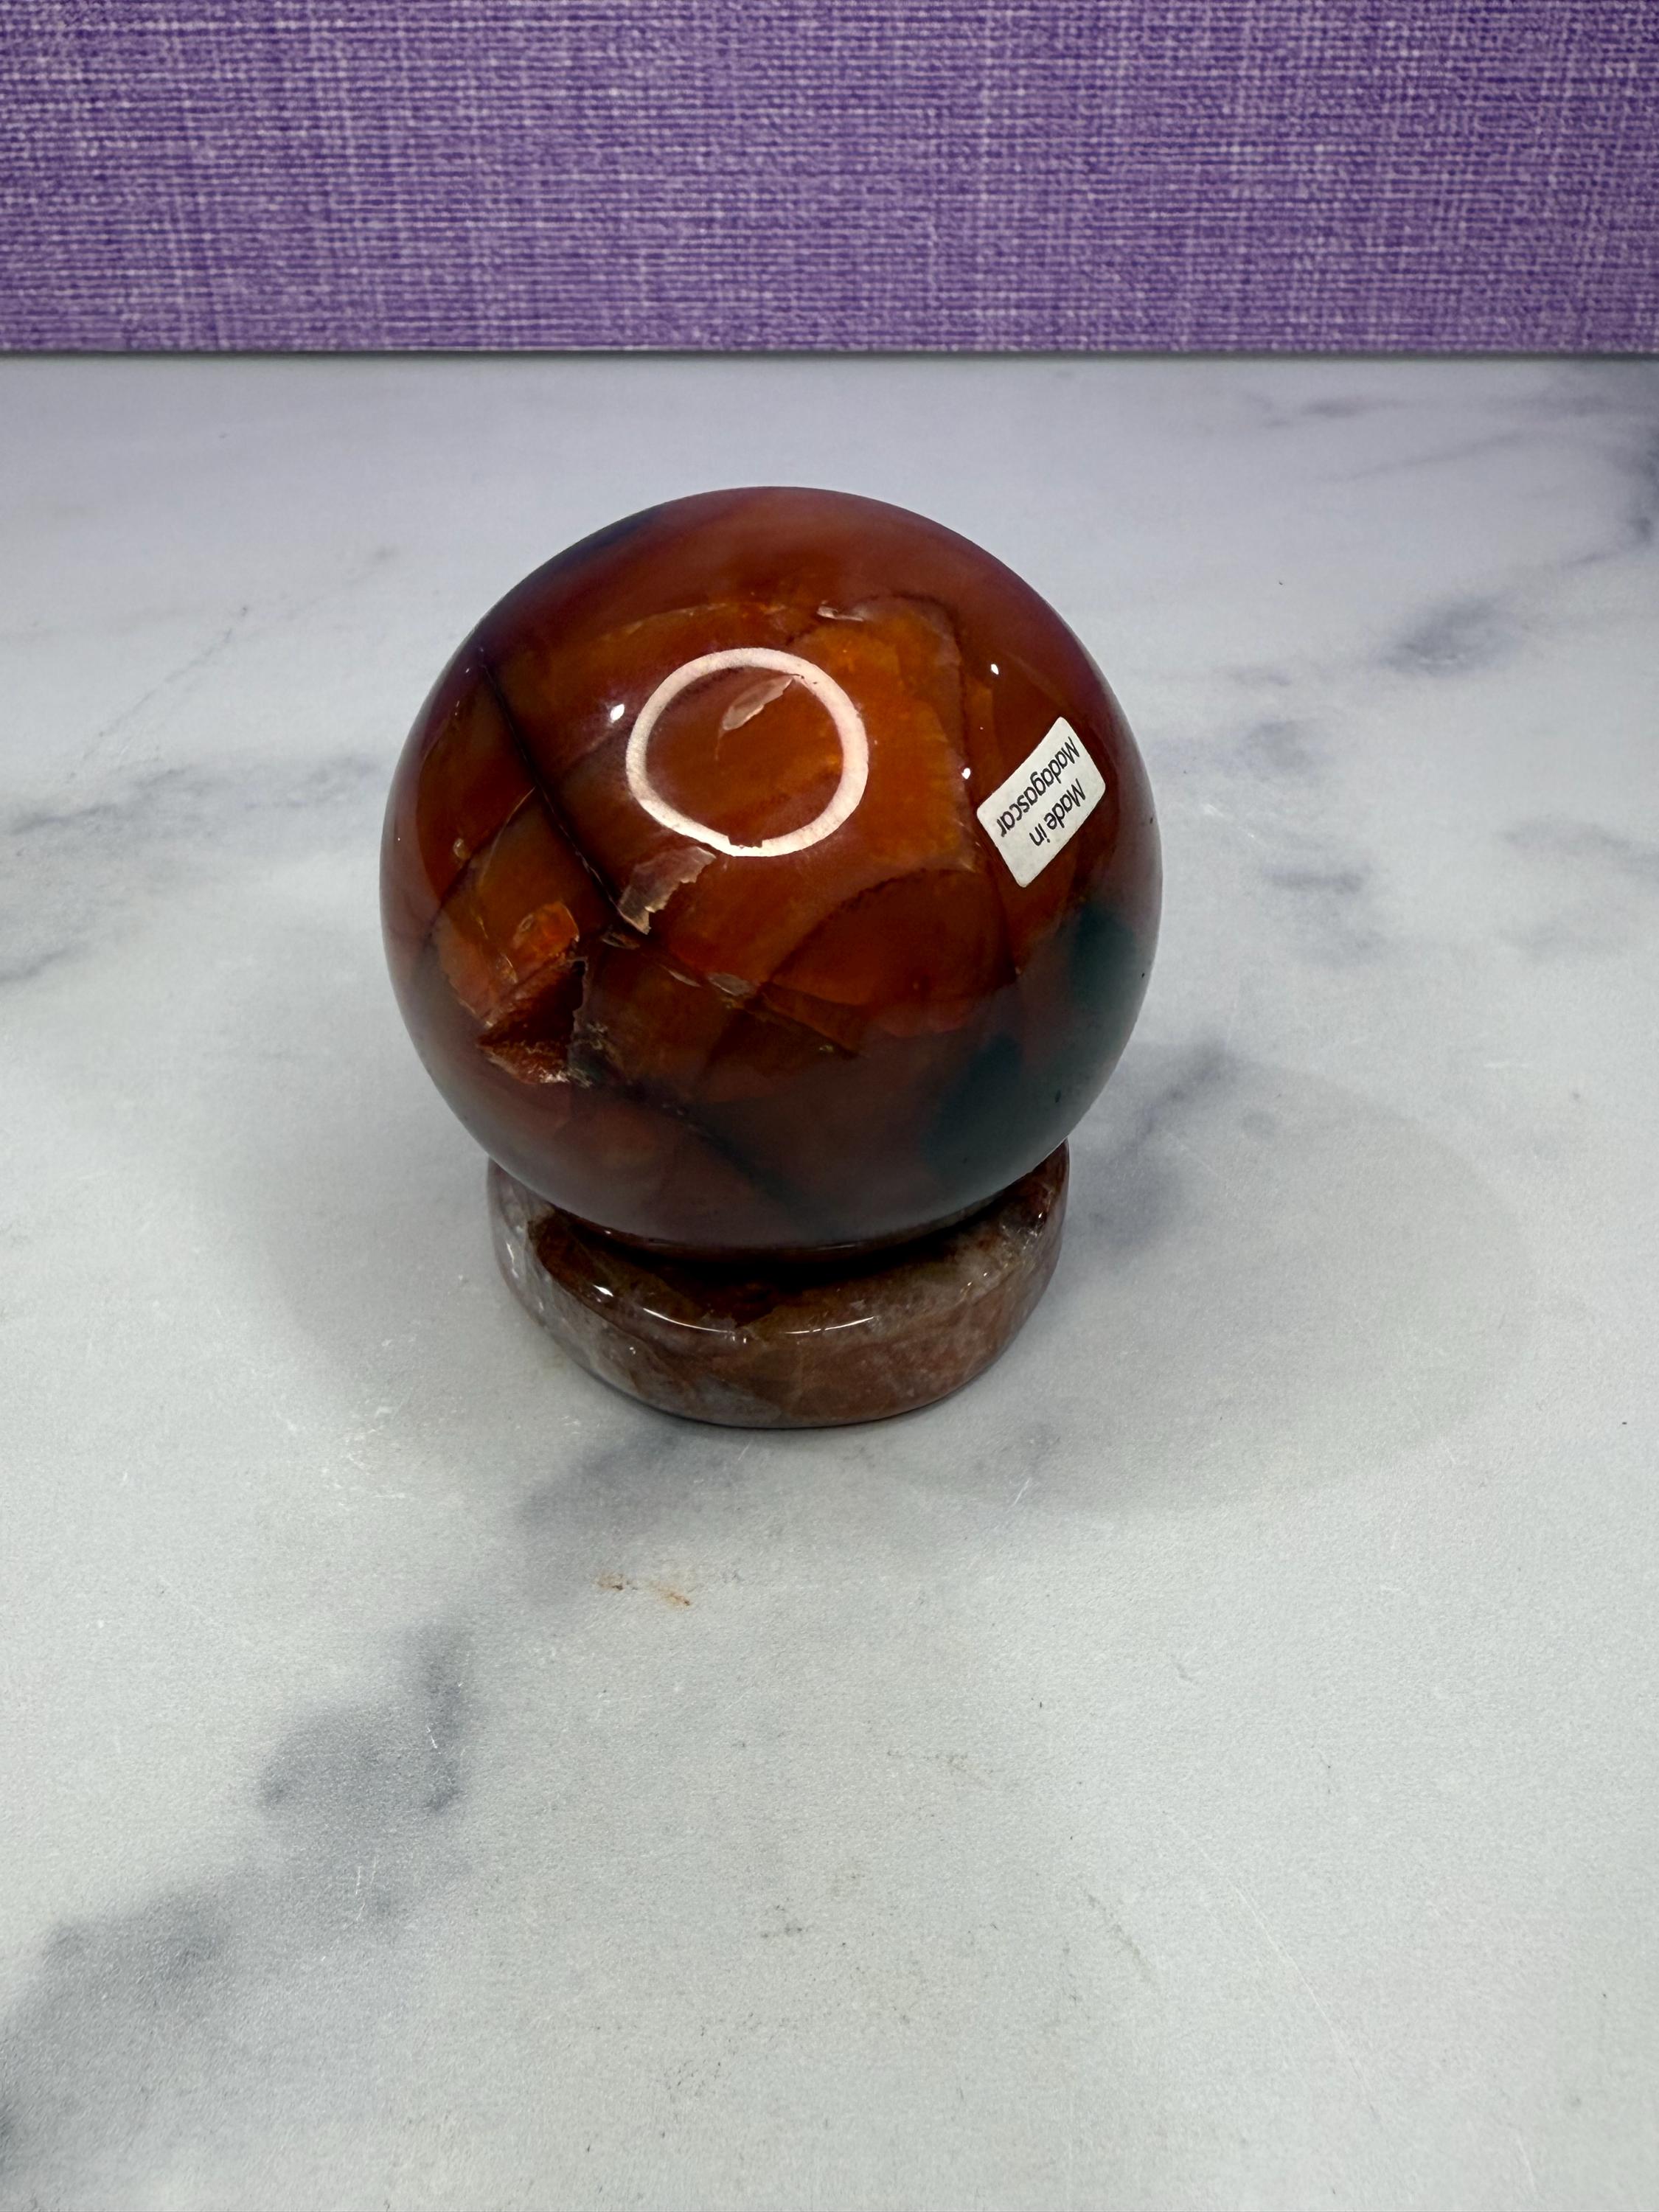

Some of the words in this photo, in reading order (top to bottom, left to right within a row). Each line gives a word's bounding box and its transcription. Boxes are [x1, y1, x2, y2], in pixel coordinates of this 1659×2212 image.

[996, 736, 1080, 838] Madagascar
[1043, 778, 1086, 830] Made
[1029, 823, 1051, 846] in
